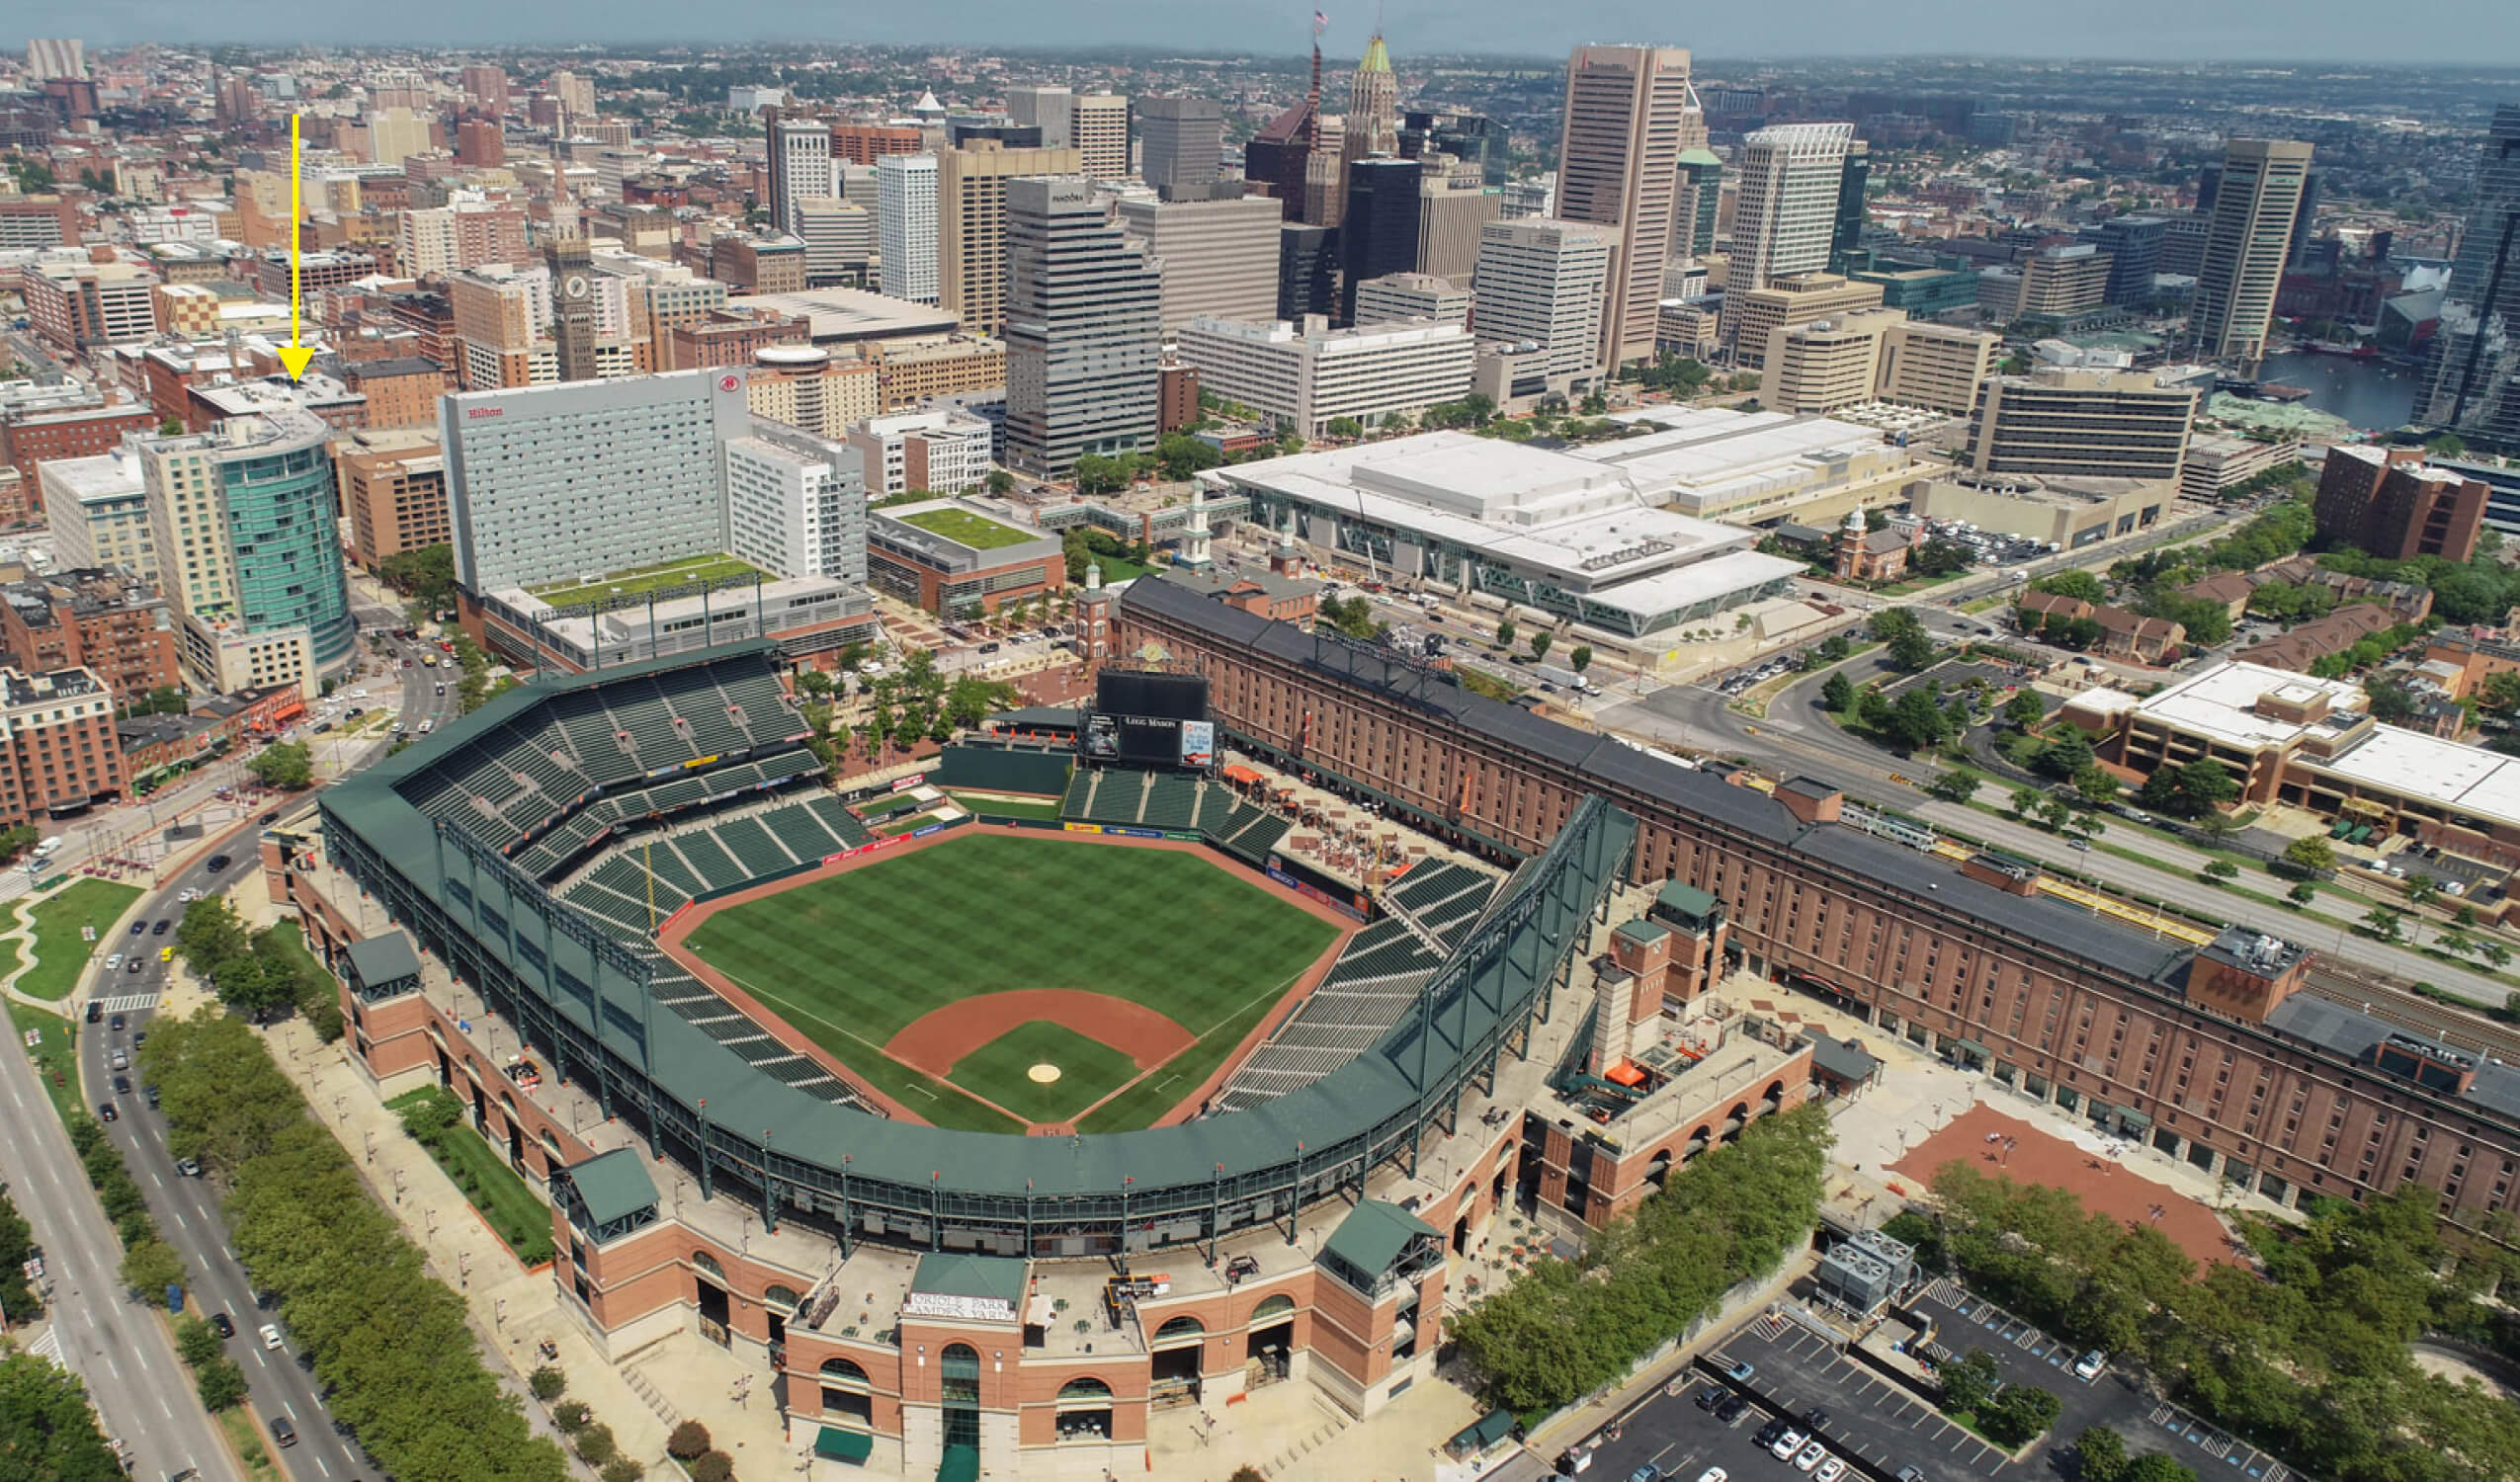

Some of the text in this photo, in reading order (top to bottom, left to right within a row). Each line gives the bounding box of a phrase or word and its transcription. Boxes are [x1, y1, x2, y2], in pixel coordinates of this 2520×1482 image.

[468, 407, 503, 419] Hilton
[913, 1294, 1006, 1310] ORIOLE PARK
